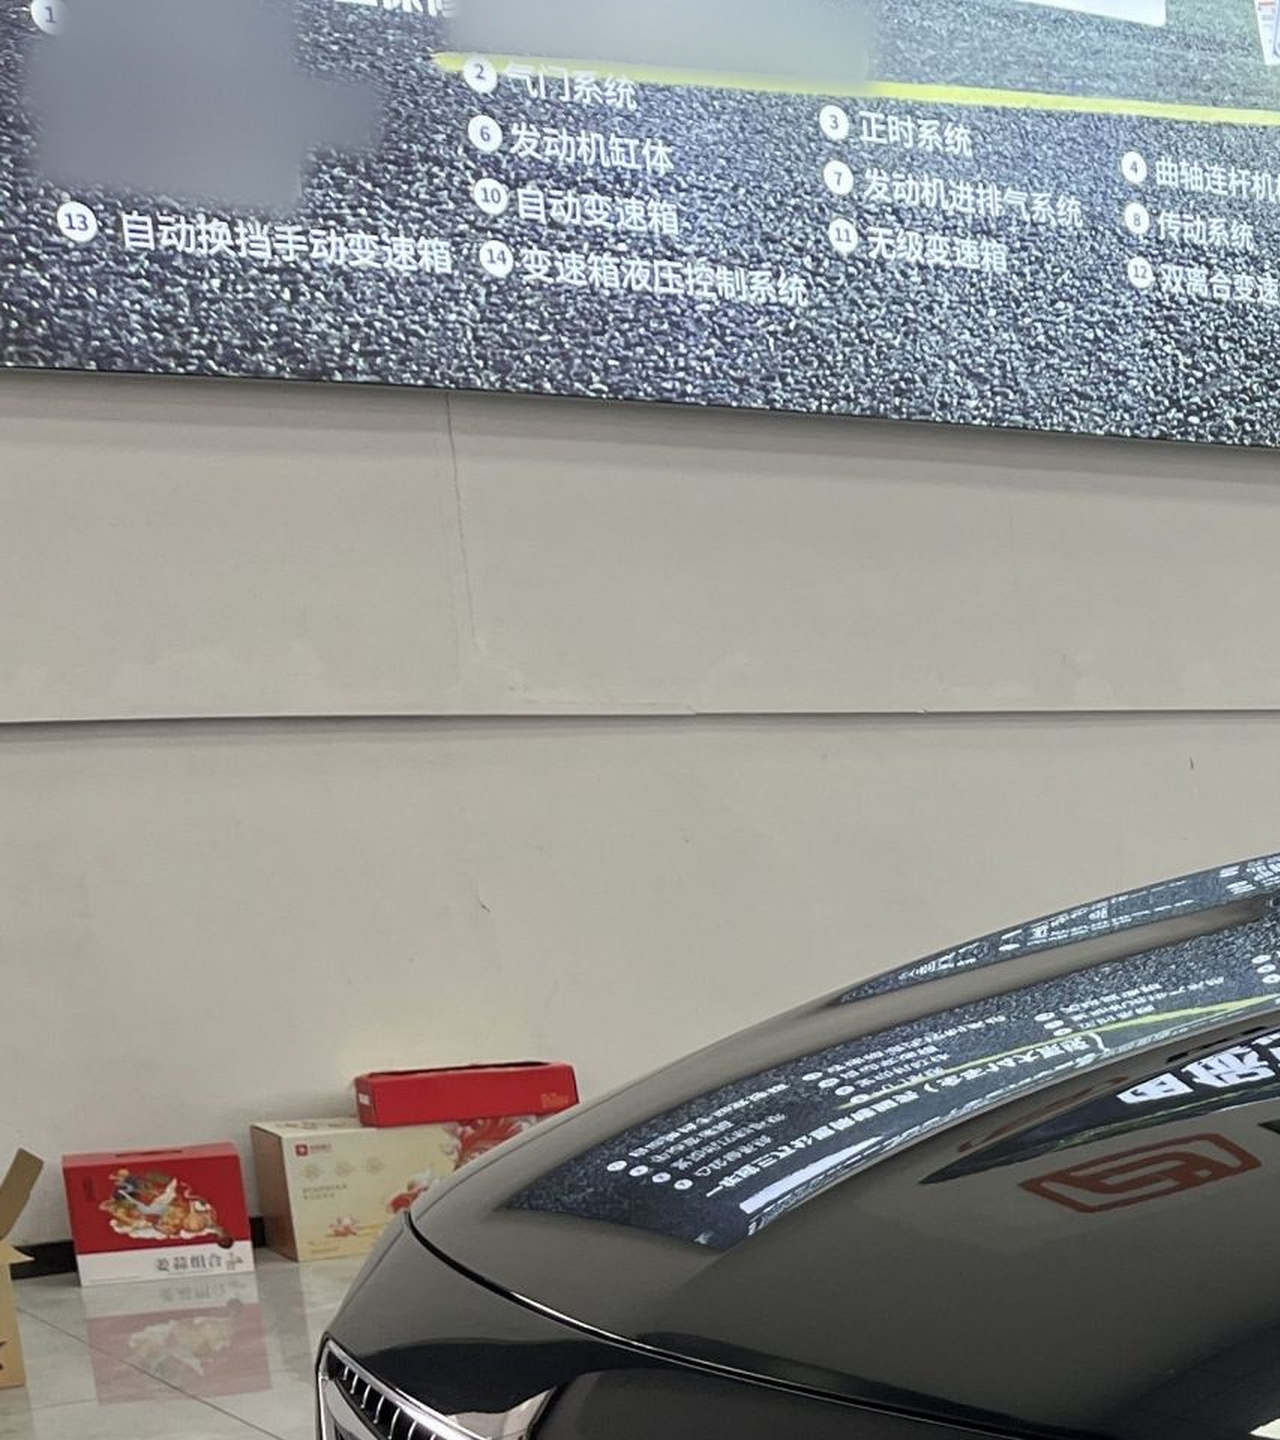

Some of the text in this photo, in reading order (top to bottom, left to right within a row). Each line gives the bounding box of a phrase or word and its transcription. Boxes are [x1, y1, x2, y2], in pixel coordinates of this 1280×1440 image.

[505, 60, 638, 111] 气门系统
[511, 122, 674, 176] 发动机缸体
[859, 110, 973, 158] 正时系统
[518, 185, 679, 236] 自动变速箱
[864, 168, 1083, 228] 发动机进排气系统
[122, 211, 452, 274] 自动换挡手动变速箱
[867, 226, 1008, 273] 无级变速箱
[1157, 209, 1254, 250] 传动系统
[522, 248, 808, 302] 变速箱液压控制系统
